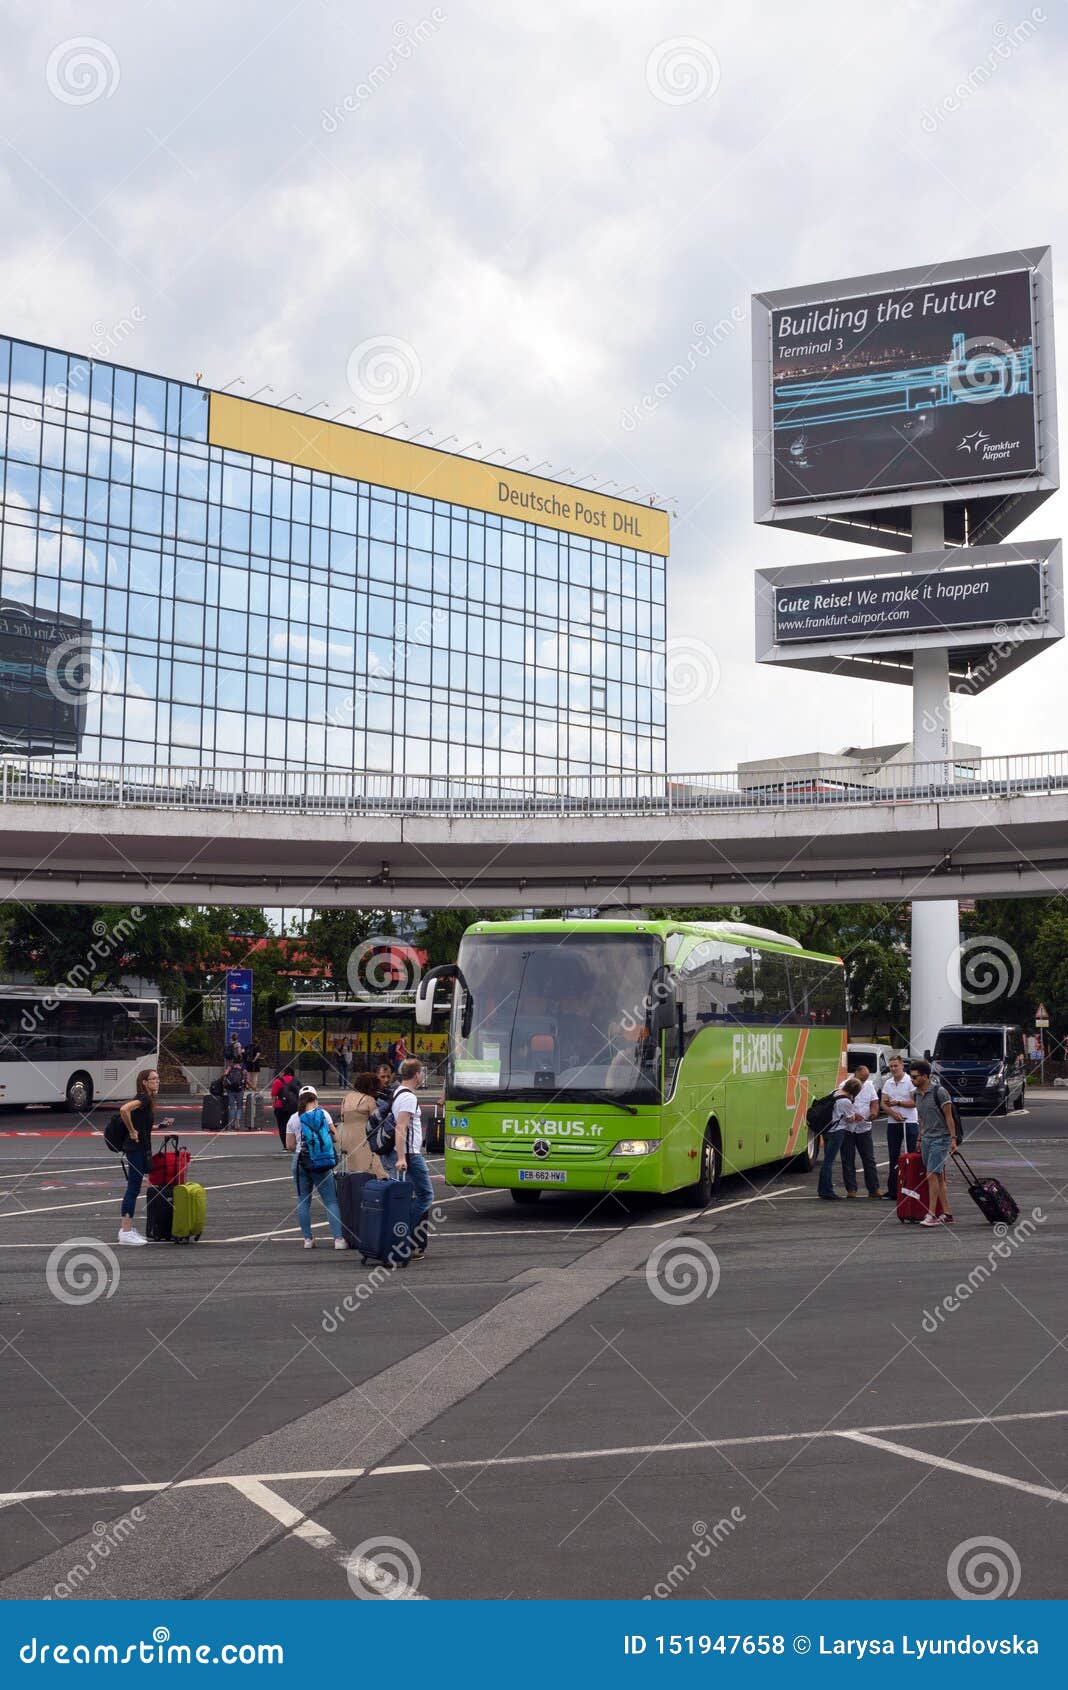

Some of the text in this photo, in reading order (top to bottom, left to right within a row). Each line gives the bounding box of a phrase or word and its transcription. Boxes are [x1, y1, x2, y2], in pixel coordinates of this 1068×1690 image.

[778, 288, 997, 338] Building the Future
[778, 338, 844, 359] Terminal 3
[982, 450, 1010, 461] Airport
[983, 440, 1020, 453] Frankfurt
[498, 482, 642, 537] Deutsche Post DHL
[778, 581, 990, 613] Gute Reise! We make it happen
[777, 609, 910, 631] www.frankfurt-airport.com
